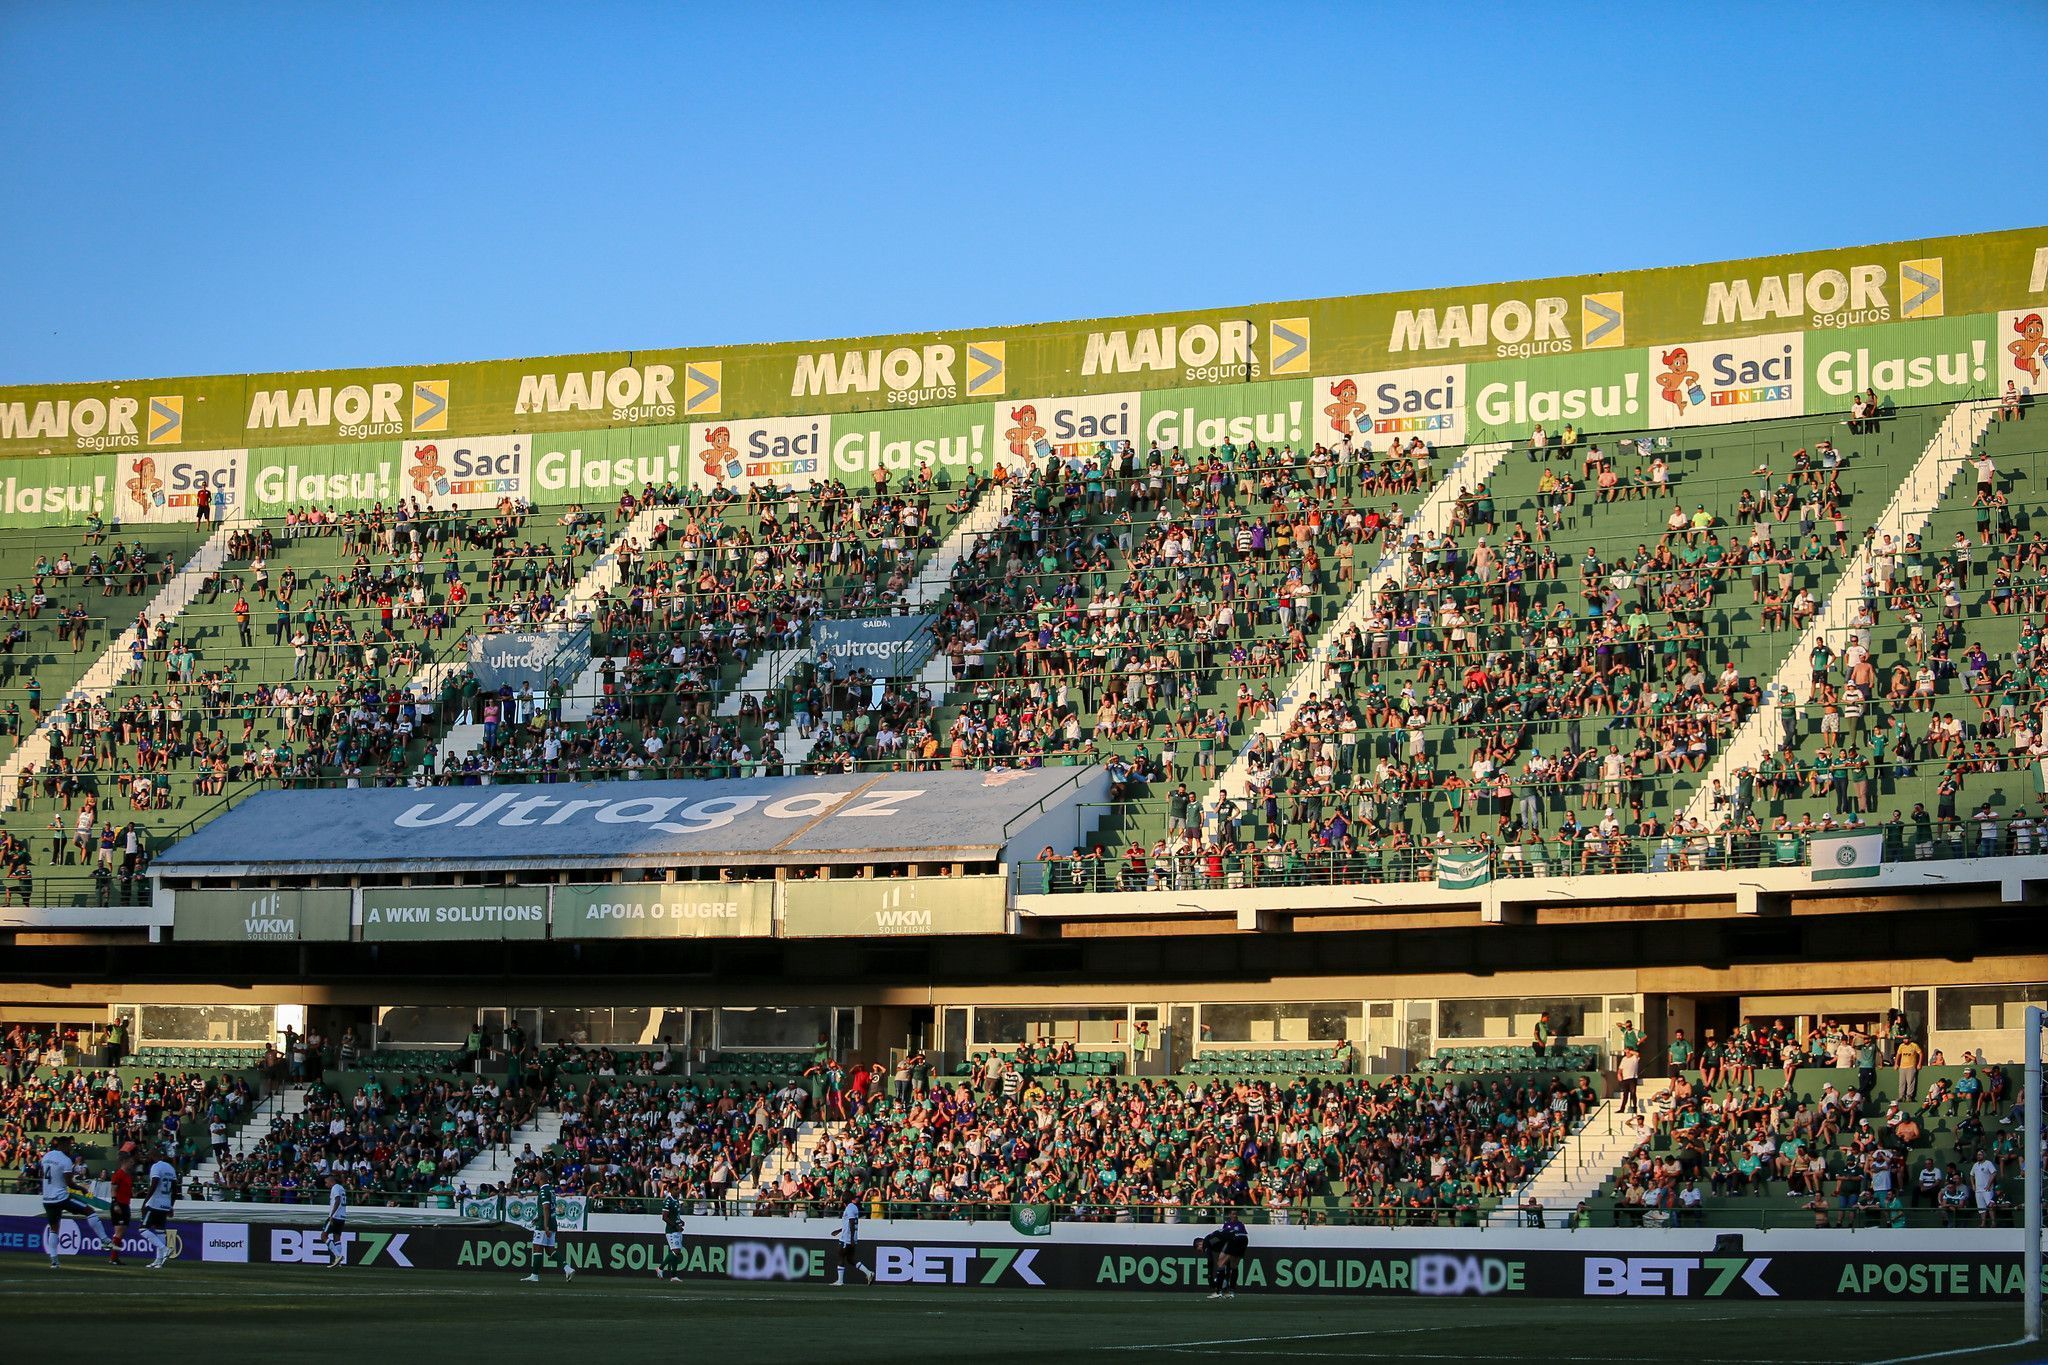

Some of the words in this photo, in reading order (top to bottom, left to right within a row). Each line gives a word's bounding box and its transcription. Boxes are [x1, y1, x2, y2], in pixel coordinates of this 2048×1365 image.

[1702, 264, 1890, 325] MAIOR
[1387, 297, 1572, 352] MAIOR
[1812, 306, 1891, 329] seguros
[1081, 320, 1259, 376] MAIOR
[1496, 339, 1572, 359] seguros
[791, 344, 956, 397] MAIOR
[1186, 363, 1261, 383] seguros
[1712, 344, 1792, 386] Saci
[1816, 340, 1987, 395] Glasu!
[246, 383, 403, 429] MAIOR
[514, 365, 675, 415] MAIOR
[887, 384, 957, 406] seguros
[1376, 375, 1454, 415] Saci
[1475, 372, 1640, 425] Glasu!
[1711, 386, 1791, 405] TINTAS
[612, 402, 676, 422] seguros
[1054, 402, 1128, 439] Saci
[1147, 401, 1303, 450] Glasu!
[1375, 415, 1452, 433] TINTAS
[77, 434, 139, 451] seguros
[339, 421, 403, 440] seguros
[748, 423, 818, 459] Saci
[453, 443, 521, 477] Saci
[833, 424, 985, 472] Glasu!
[172, 459, 236, 490] Saci
[255, 462, 391, 503] Glasu!
[536, 445, 681, 490] Glasu!
[748, 460, 816, 476] TINTAS
[0, 476, 106, 513] lasu!
[169, 493, 234, 507] TINAS
[452, 479, 518, 494] TINTAS
[835, 640, 914, 659] ultragaz
[394, 790, 927, 834] ultragaz
[245, 919, 294, 933] WKM
[368, 907, 381, 923] A
[385, 907, 430, 923] WKM
[435, 905, 543, 922] SOLUTIONS
[586, 903, 645, 919] APOIA
[651, 903, 664, 919] O
[671, 902, 738, 918] BUGRE
[875, 910, 932, 925] WKM
[878, 925, 932, 934] SOLUTIONS
[209, 1239, 243, 1250] uhlsport
[566, 1242, 603, 1269] NA
[875, 1246, 1046, 1286] BET7K
[1275, 1256, 1525, 1295] SOLIDARIEDADE
[1584, 1257, 1780, 1296] BET7K
[1837, 1263, 1969, 1295] APOSTE
[1980, 1264, 2025, 1295] NA
